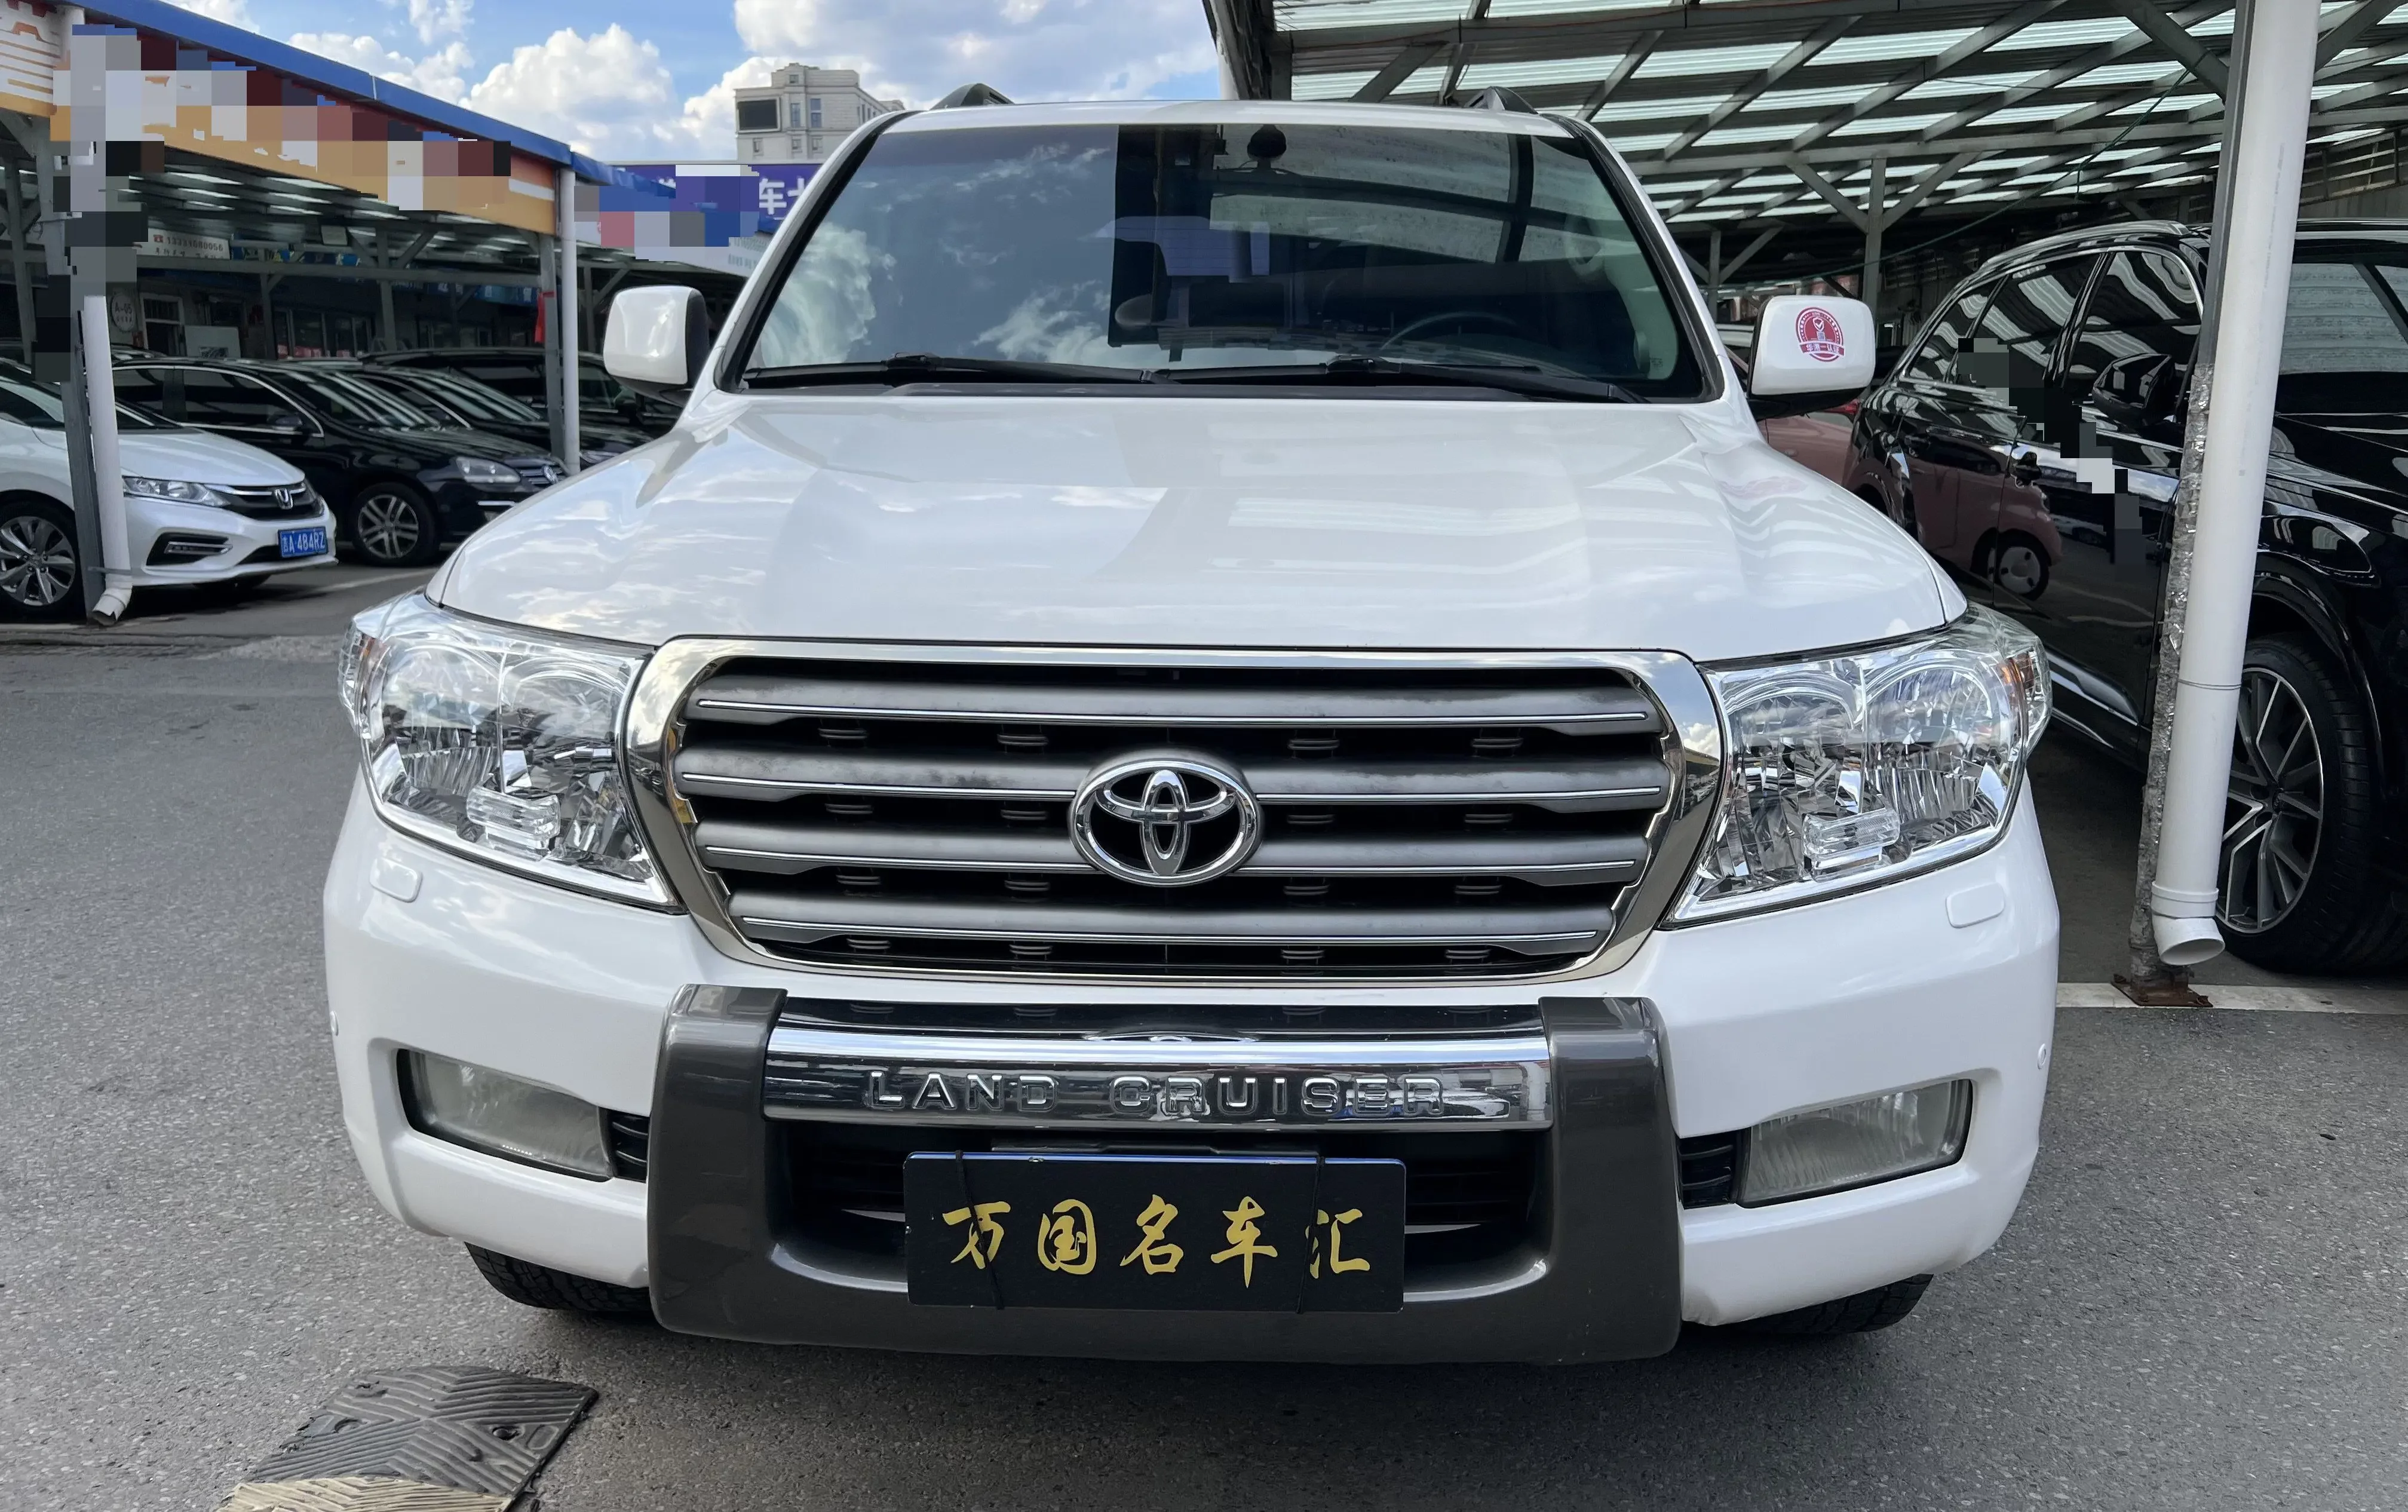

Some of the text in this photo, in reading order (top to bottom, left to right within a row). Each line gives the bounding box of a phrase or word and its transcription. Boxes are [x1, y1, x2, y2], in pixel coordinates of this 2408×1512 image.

[869, 1071, 1444, 1117] LAND CRUISER
[942, 1194, 1371, 1289] 万国名车汇
